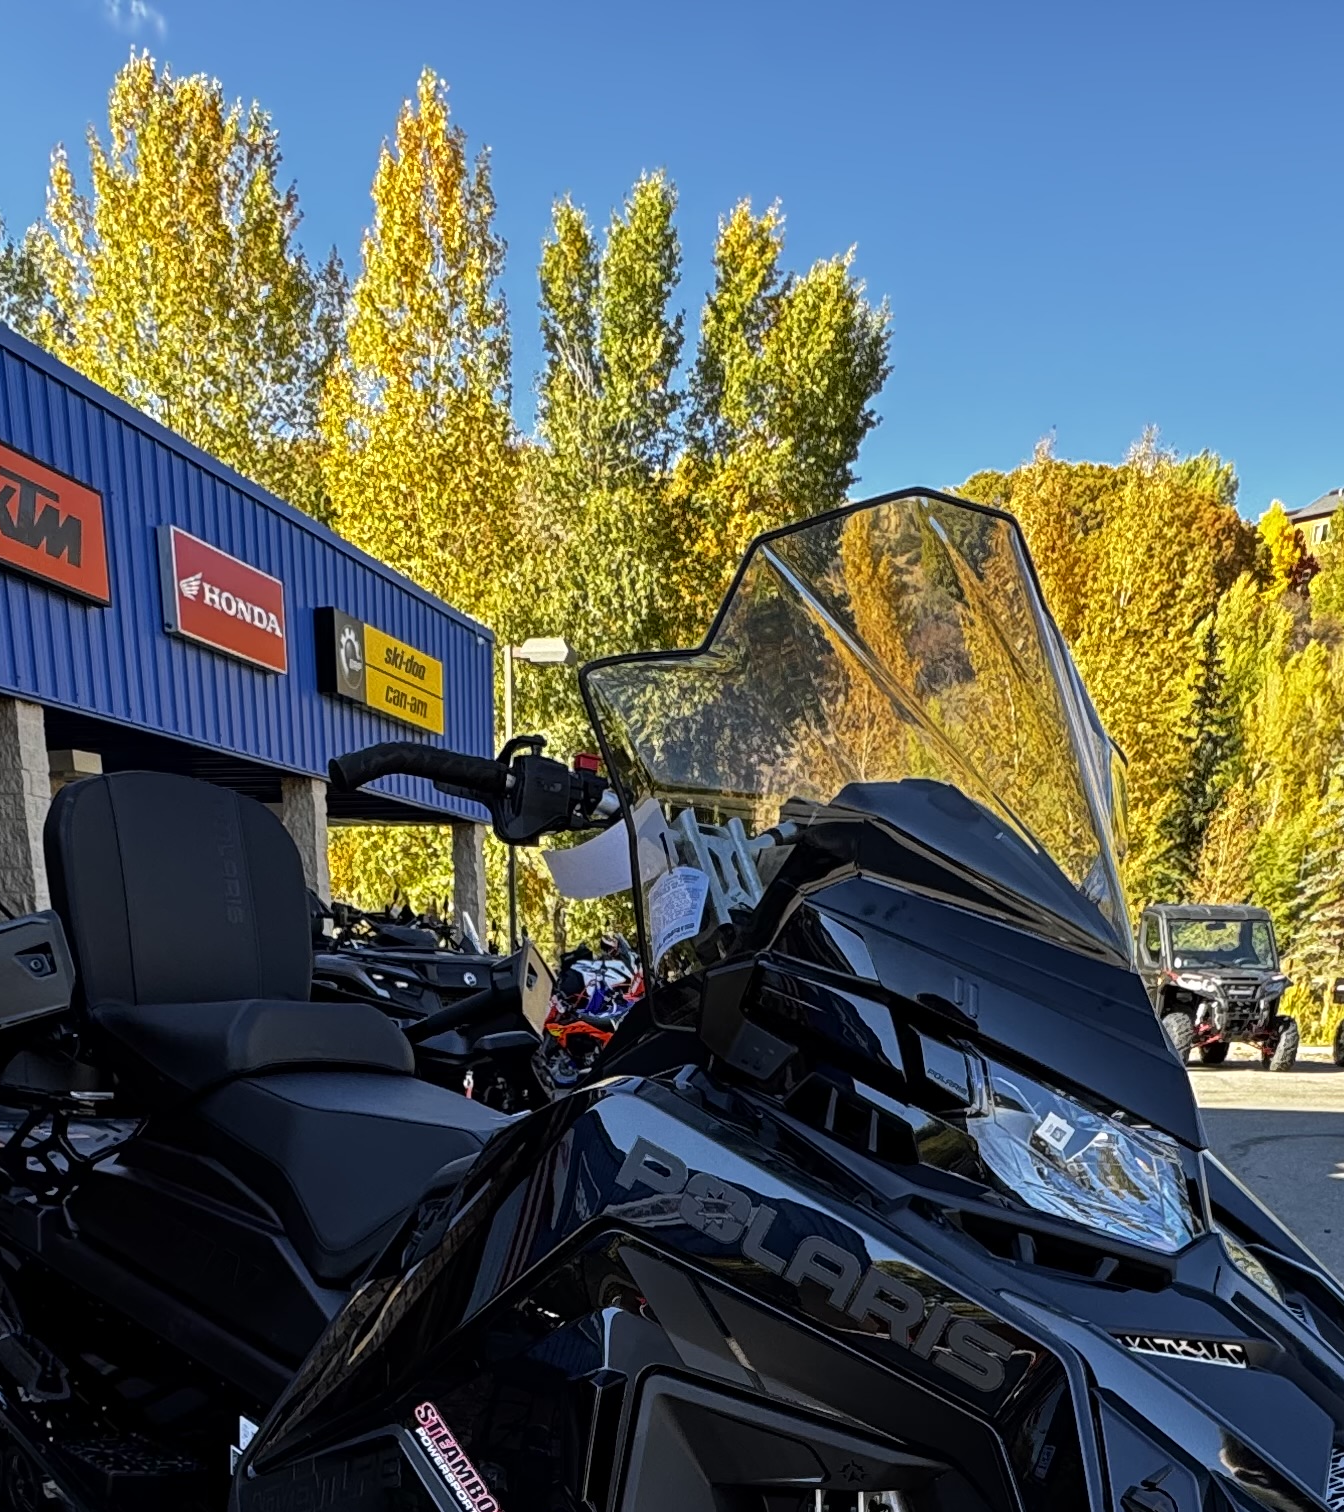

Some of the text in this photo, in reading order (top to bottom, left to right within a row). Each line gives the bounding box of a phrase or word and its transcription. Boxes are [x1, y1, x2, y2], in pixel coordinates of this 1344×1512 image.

[202, 581, 283, 638] HONDA
[384, 646, 426, 681] ski-doo
[385, 685, 428, 718] can-am
[927, 1067, 968, 1096] POLARIS
[614, 1134, 1021, 1393] POLARIS
